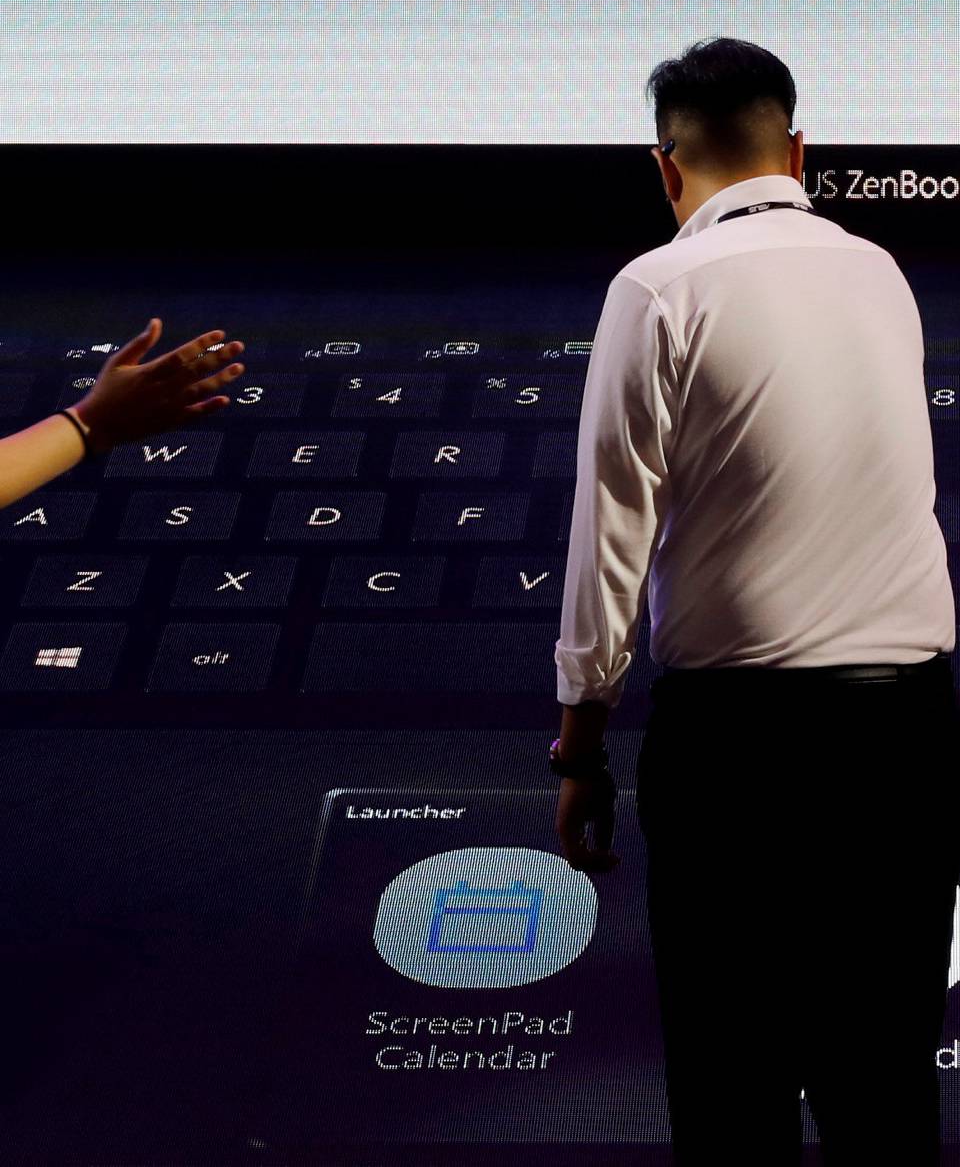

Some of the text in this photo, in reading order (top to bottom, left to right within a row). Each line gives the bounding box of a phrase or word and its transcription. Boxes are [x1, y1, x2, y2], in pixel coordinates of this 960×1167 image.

[237, 388, 263, 403] 3
[378, 388, 401, 403] 4
[517, 388, 539, 403] 5
[931, 389, 955, 405] 8
[144, 446, 186, 461] W
[293, 446, 317, 462] E
[435, 446, 460, 462] R
[16, 508, 46, 525] A
[166, 507, 191, 524] S
[309, 508, 340, 525] D
[458, 508, 484, 525] F
[67, 572, 100, 590] Z
[217, 572, 249, 590] X
[368, 572, 400, 591] C
[520, 572, 547, 589] V
[194, 652, 229, 665] alt
[346, 804, 466, 819] Launcher
[366, 1011, 571, 1034] ScreenPad
[376, 1045, 554, 1069] Calendar
